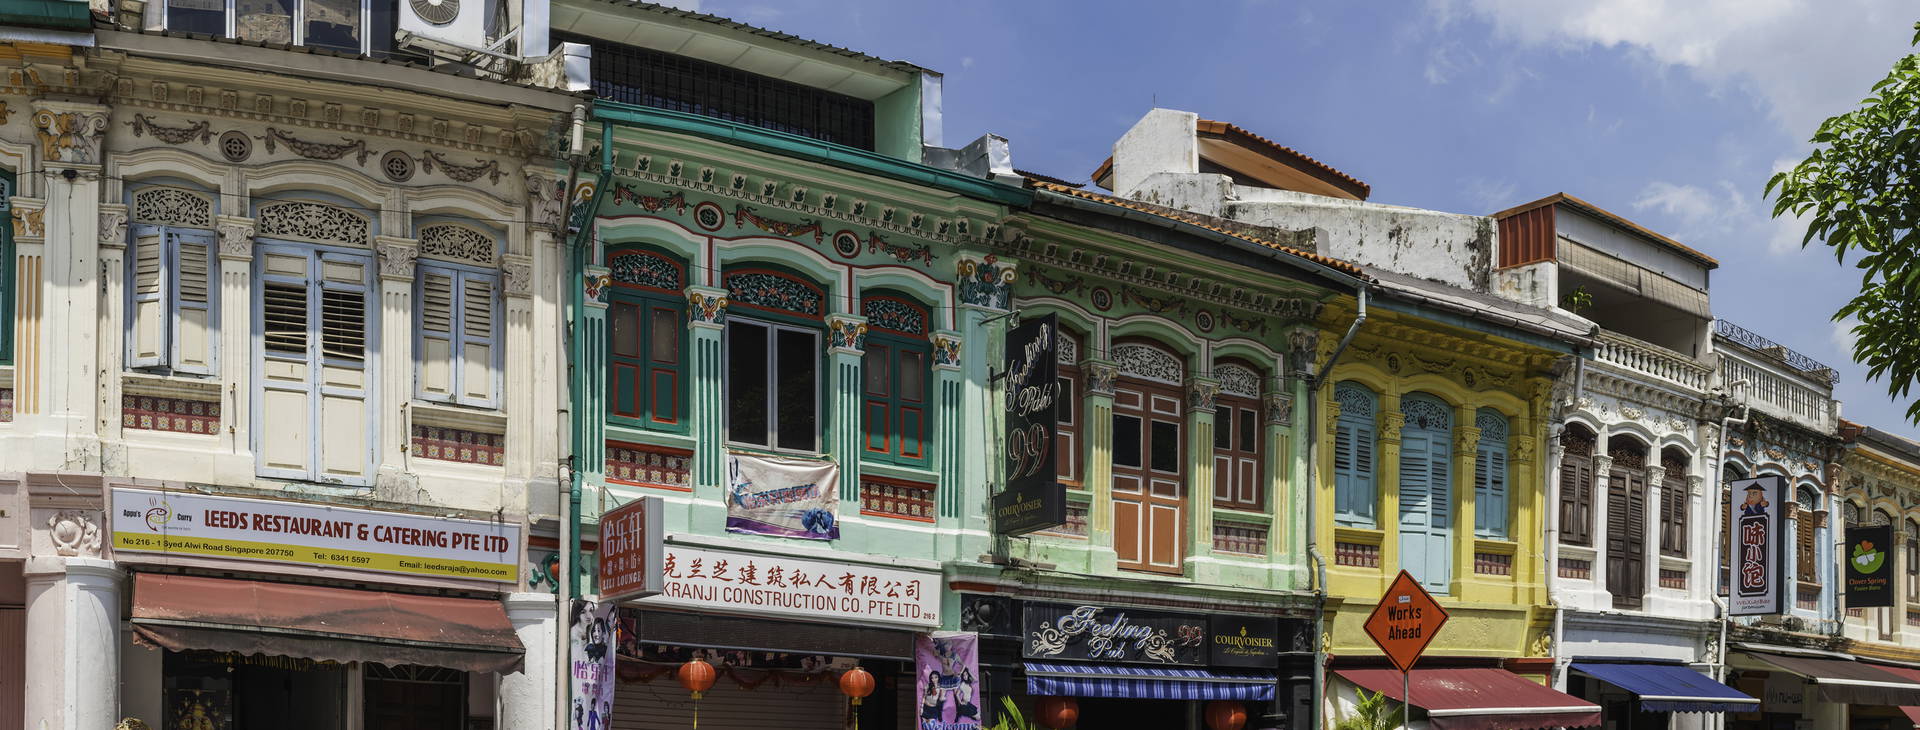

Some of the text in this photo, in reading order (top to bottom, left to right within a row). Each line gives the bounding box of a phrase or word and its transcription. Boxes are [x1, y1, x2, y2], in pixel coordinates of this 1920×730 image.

[1005, 322, 1050, 412] Feeling
[1008, 422, 1049, 481] 99
[177, 513, 192, 522] Curry
[998, 498, 1042, 518] COURVOISIER
[205, 509, 509, 553] LEEDS RESTAURANT & CATERING PTE LTD
[123, 537, 134, 545] No
[135, 538, 150, 546] 216
[163, 540, 182, 550] Syed
[184, 541, 200, 549] Alwi
[202, 543, 223, 552] Road
[224, 544, 264, 556] Singapore
[265, 548, 294, 557] 207750
[313, 552, 370, 564] Tel: 6341 5597
[399, 560, 507, 576] Email: leedsraja@yahoo.com
[617, 571, 641, 587] LOUNGE
[663, 553, 921, 602] 克兰芝建筑私人有限公司
[662, 582, 718, 602] KRANJI
[723, 586, 837, 611] CONSTRUCTION
[841, 597, 864, 613] CO.
[868, 600, 893, 616] PTE
[897, 602, 920, 619] LTD
[1388, 604, 1422, 621] Works
[1058, 605, 1154, 649] Feeling
[1177, 624, 1203, 647] 99
[1388, 623, 1421, 641] Ahead
[1087, 636, 1125, 659] Pub
[1215, 634, 1273, 649] COURVOISIER
